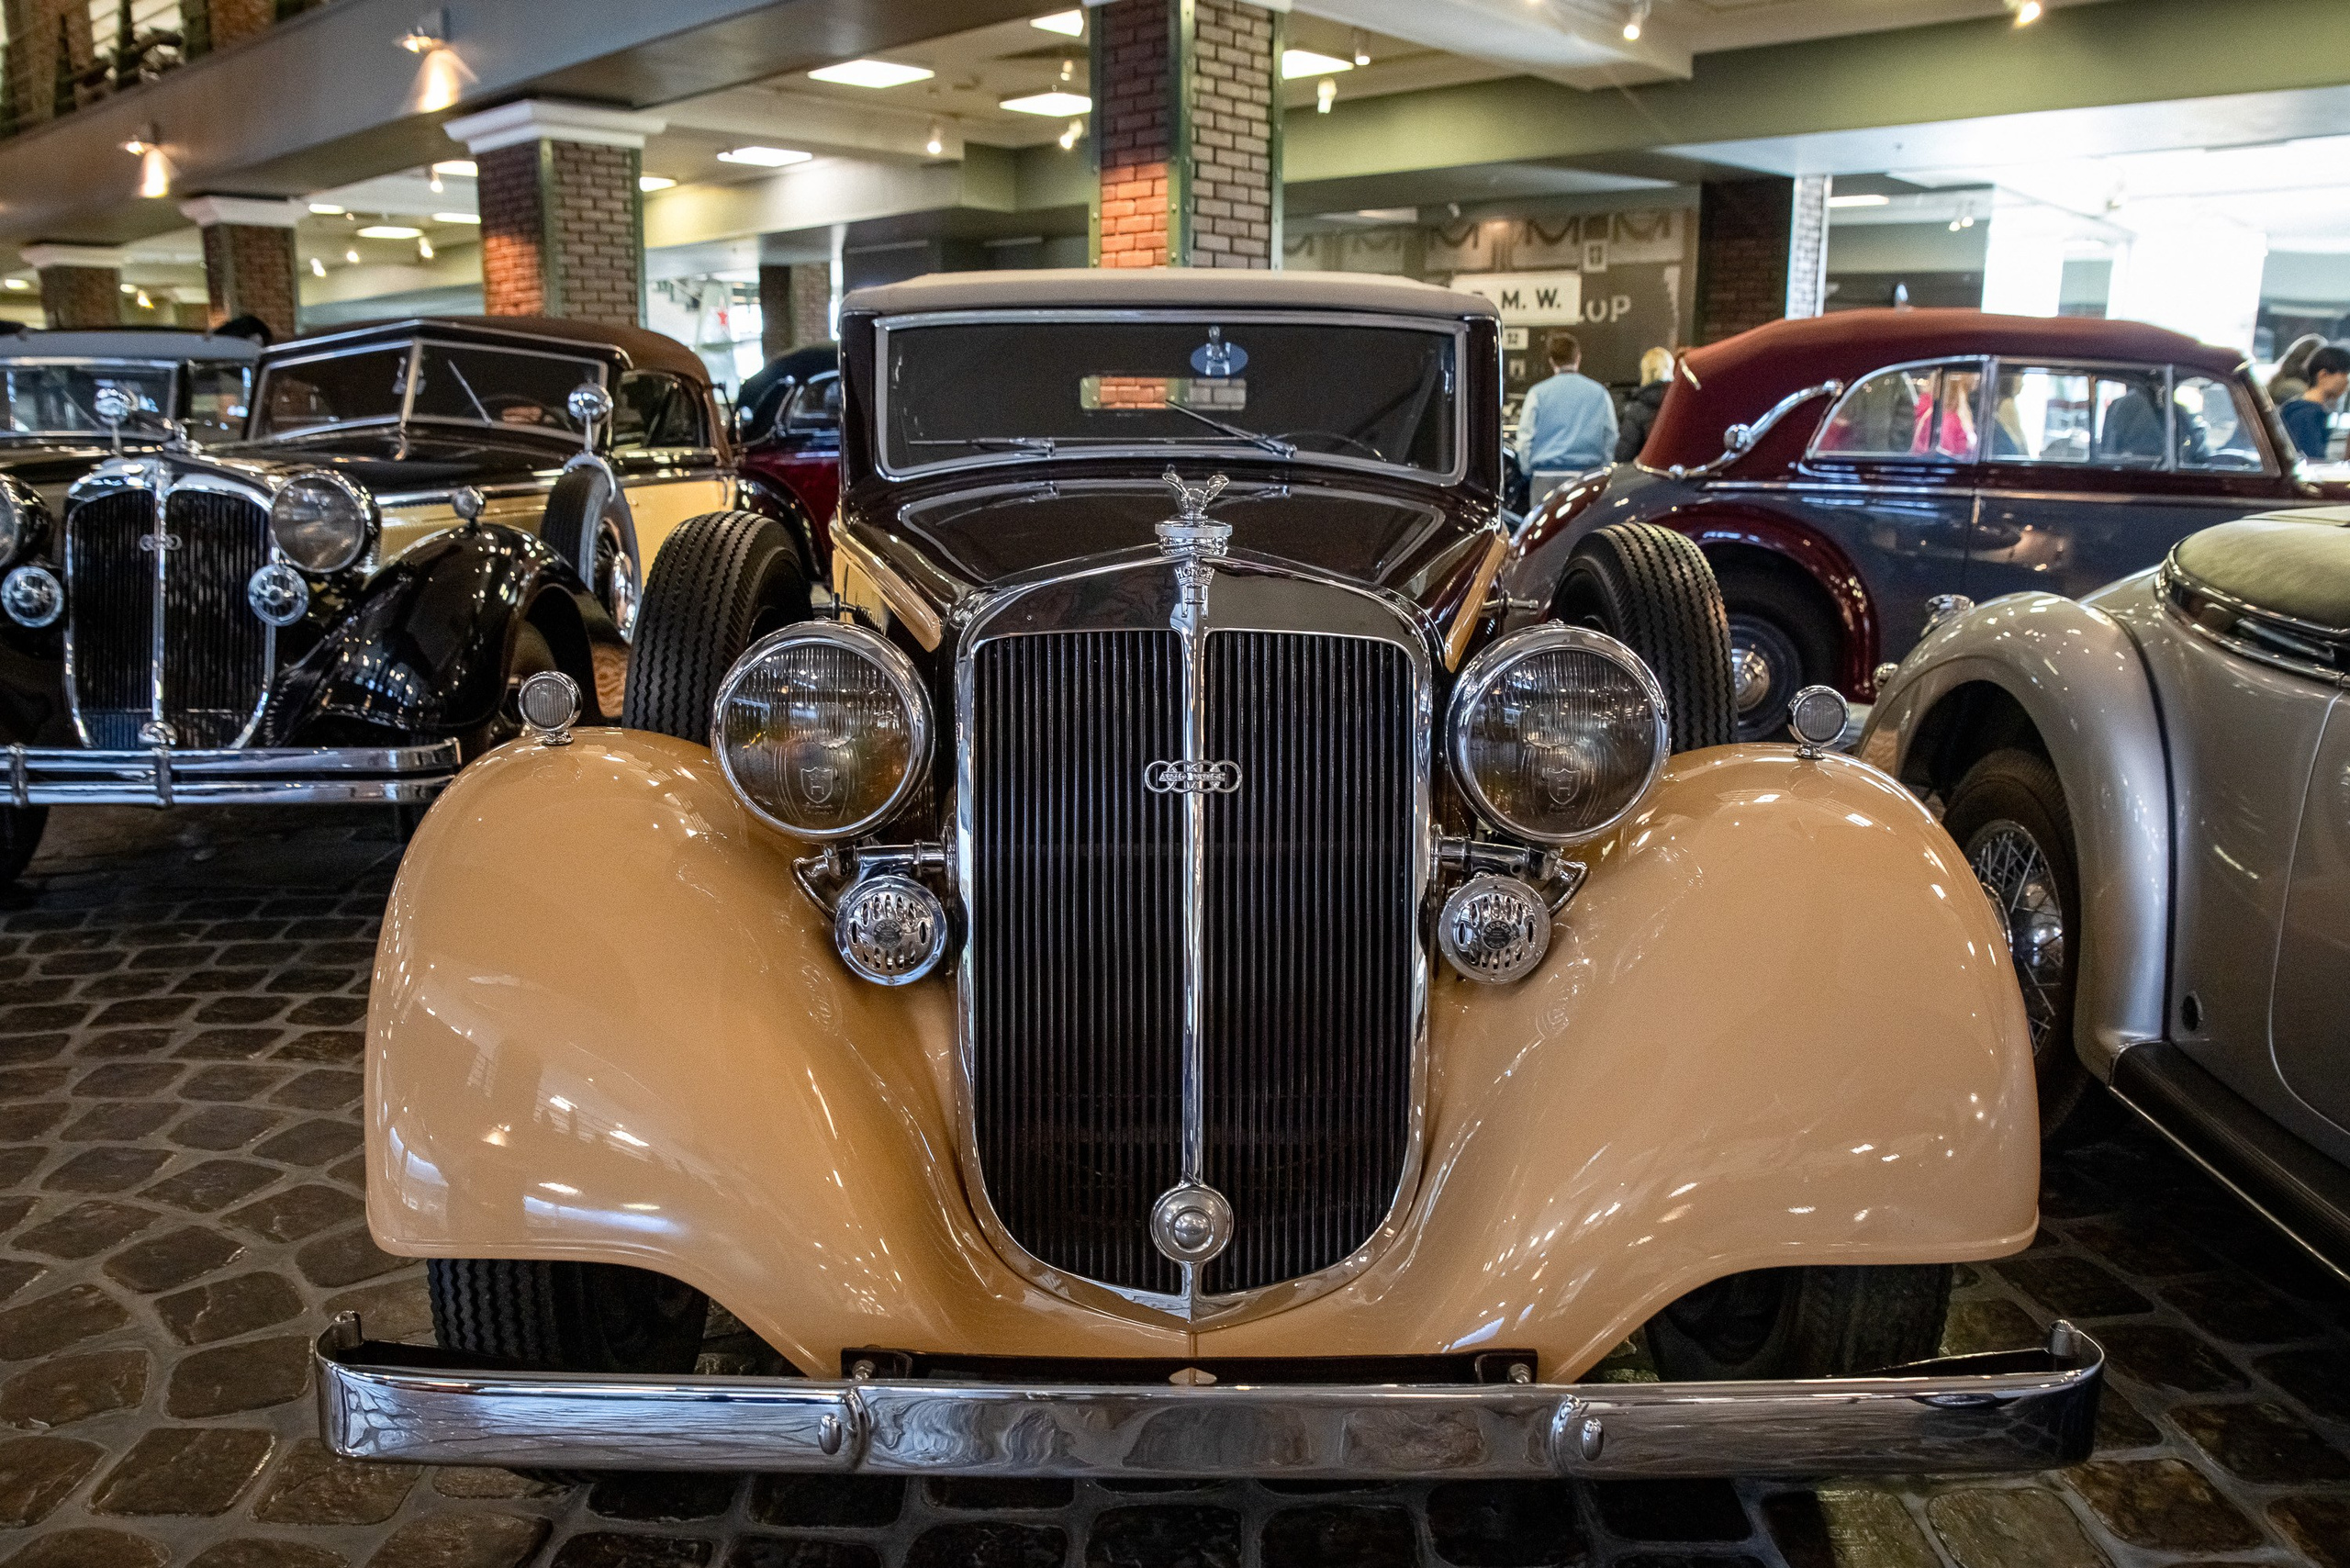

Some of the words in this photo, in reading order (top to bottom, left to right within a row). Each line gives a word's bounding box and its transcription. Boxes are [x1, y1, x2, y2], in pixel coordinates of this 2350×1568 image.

[1501, 289, 1527, 310] M.
[1536, 287, 1561, 309] W.
[876, 921, 901, 933] BOSCH
[1485, 921, 1511, 933] BOSCH
